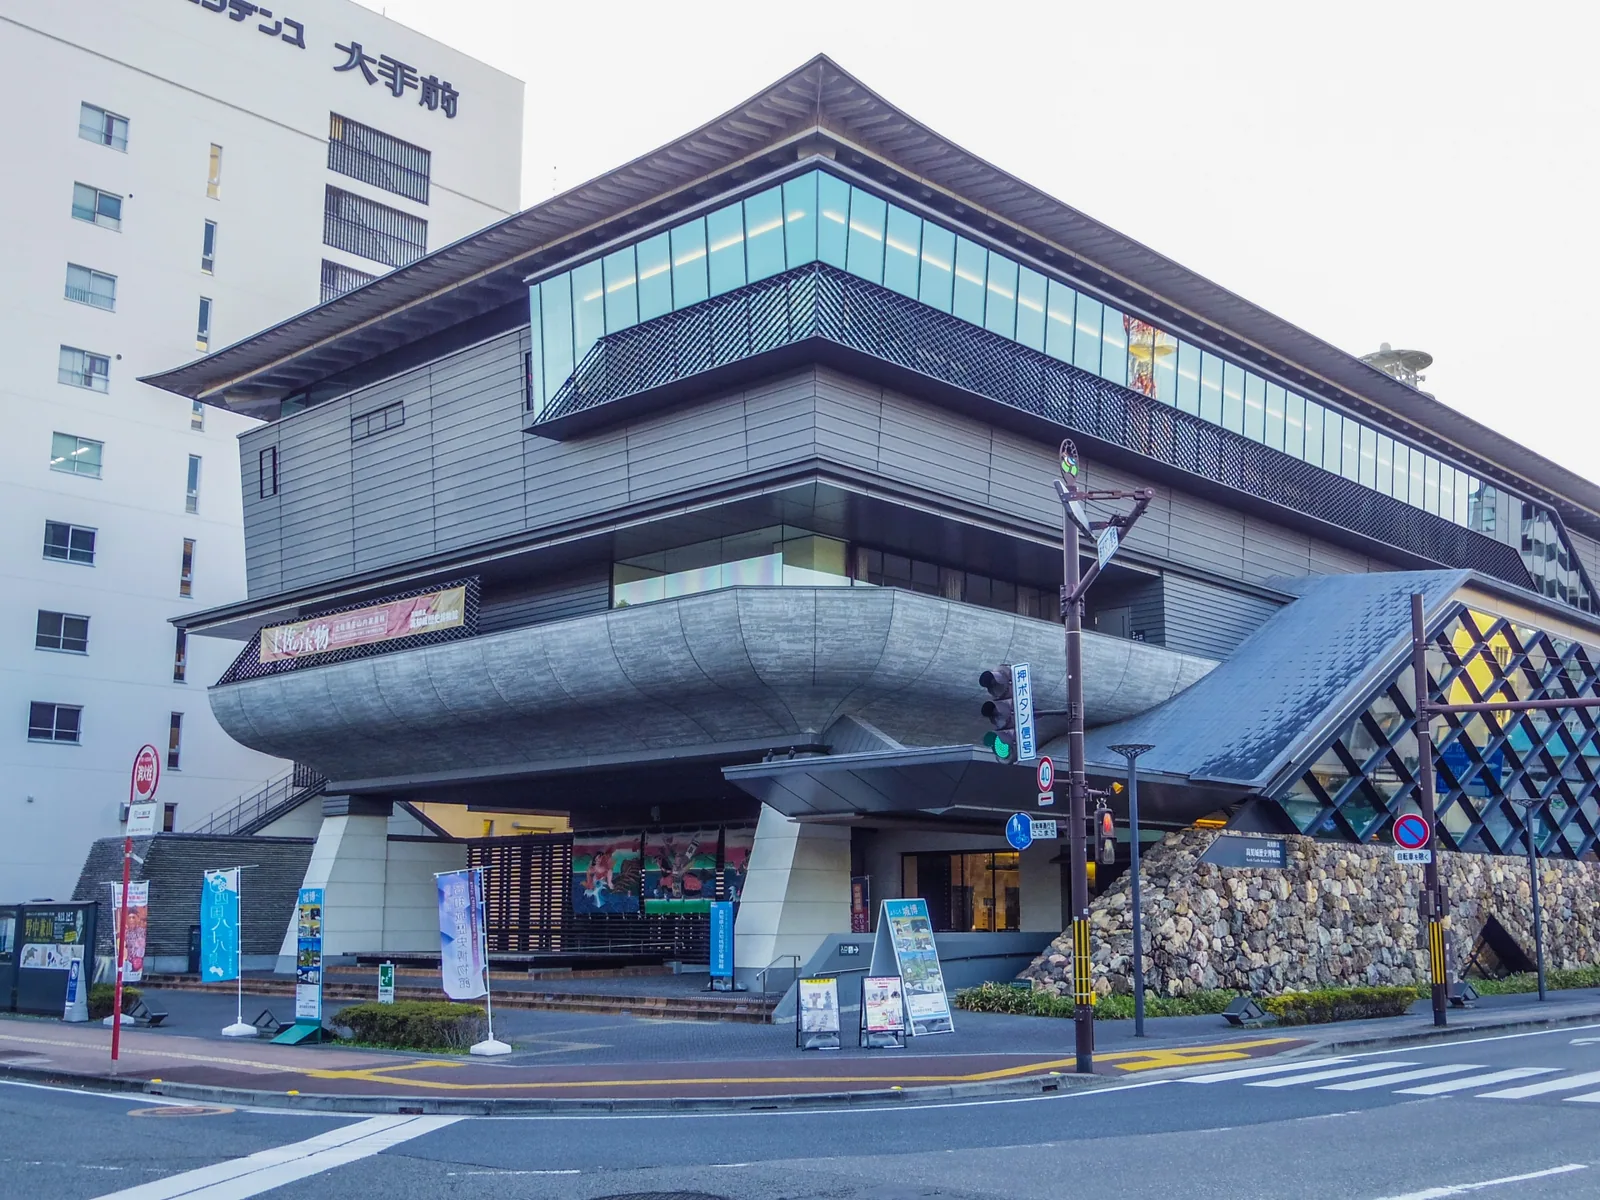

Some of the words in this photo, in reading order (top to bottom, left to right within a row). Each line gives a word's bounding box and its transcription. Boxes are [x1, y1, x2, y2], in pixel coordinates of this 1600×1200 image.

[333, 41, 459, 119] 大手前
[1017, 669, 1032, 754] 押ボタン信号
[137, 765, 153, 781] 消火栓
[1041, 766, 1049, 782] 40
[1397, 852, 1429, 861] 自転車を除く
